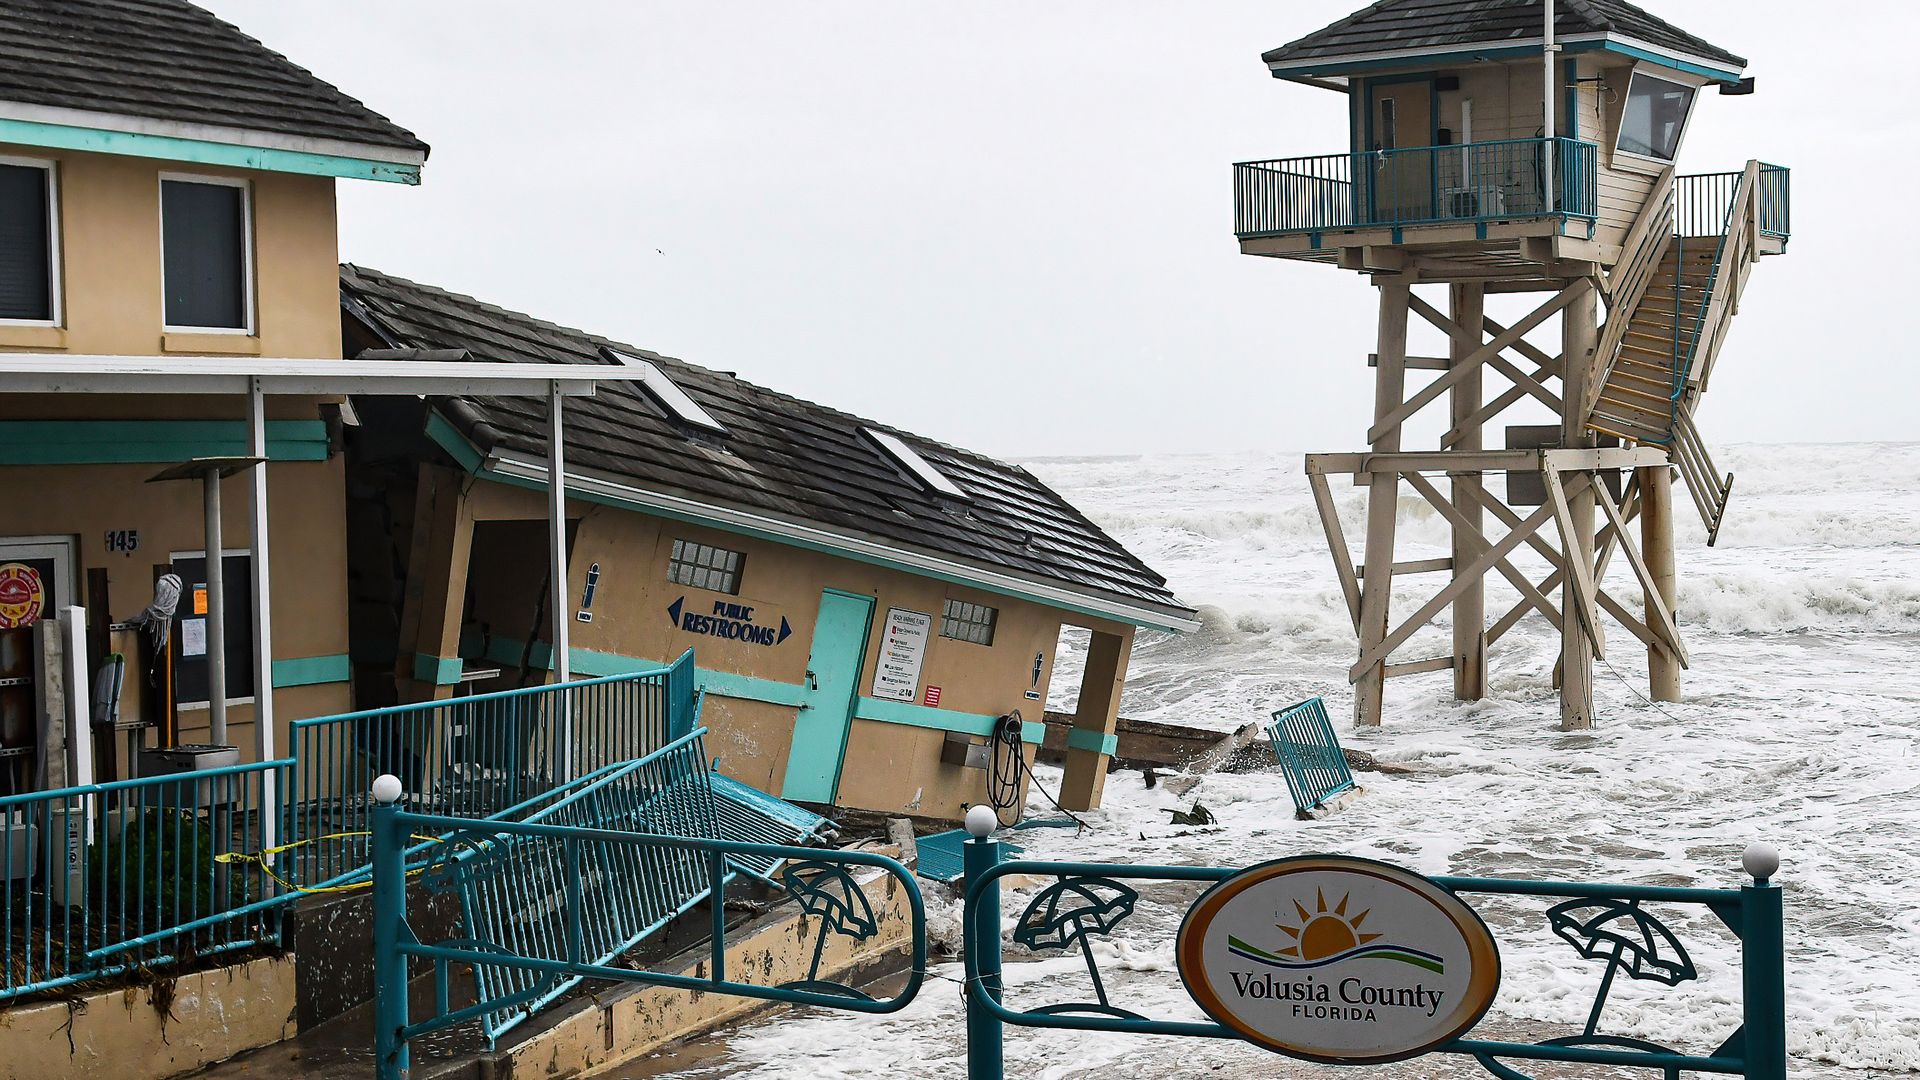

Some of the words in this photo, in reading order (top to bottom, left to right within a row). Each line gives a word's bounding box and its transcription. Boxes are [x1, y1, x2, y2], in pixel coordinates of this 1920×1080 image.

[108, 530, 137, 551] 145
[713, 600, 755, 622] PUBLIC
[682, 612, 776, 646] RESTROOMS
[1229, 970, 1331, 1003] Volusia
[1338, 977, 1445, 1018] County
[1291, 1004, 1377, 1022] FLORIDA
